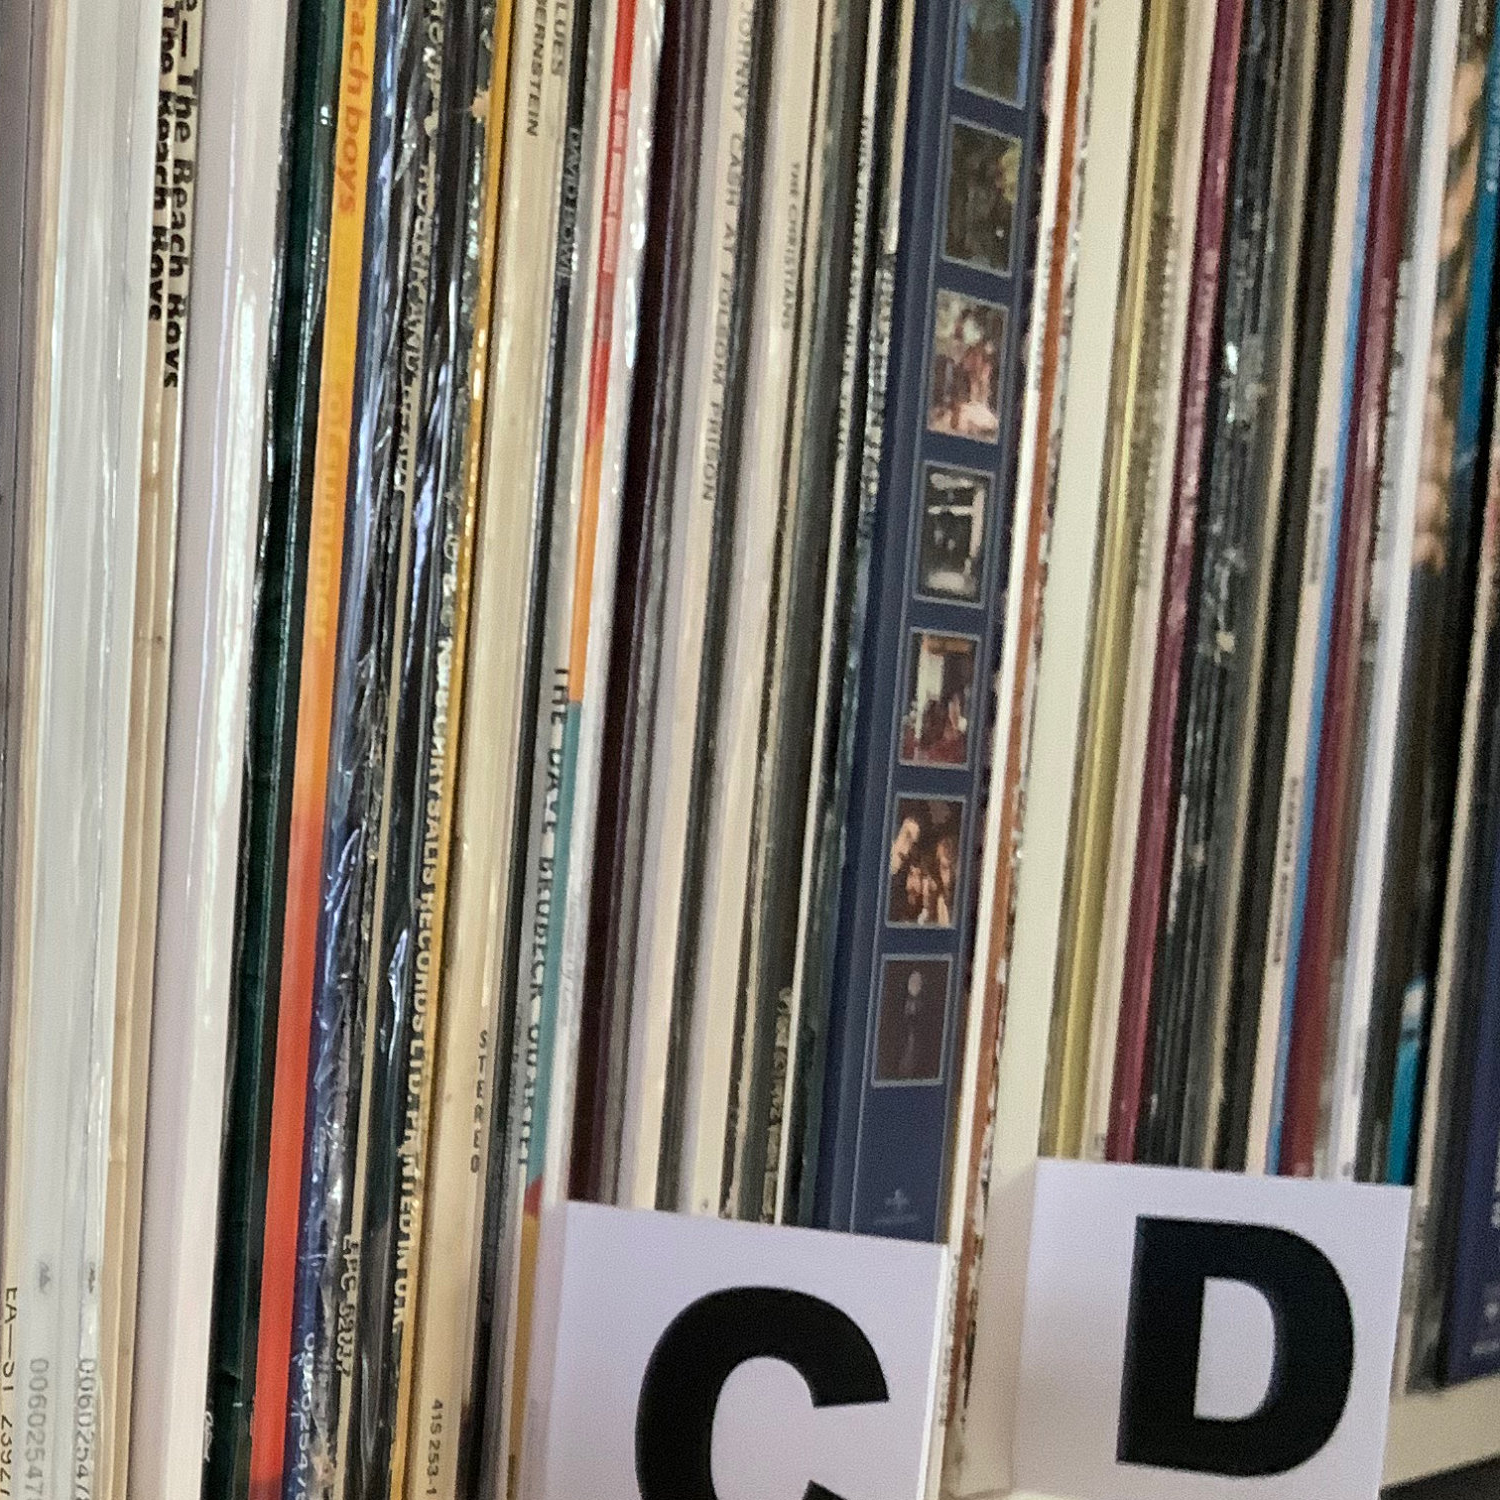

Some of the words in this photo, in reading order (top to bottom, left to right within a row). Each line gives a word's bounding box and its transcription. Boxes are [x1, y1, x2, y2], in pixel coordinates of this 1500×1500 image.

[174, 70, 200, 142] The
[335, 106, 362, 215] boys
[726, 134, 743, 207] CASH
[169, 159, 197, 278] Beach
[163, 293, 189, 389] Boys
[703, 402, 721, 501] PRISON
[412, 894, 438, 1033] RECORDS
[1116, 1216, 1354, 1478] D
